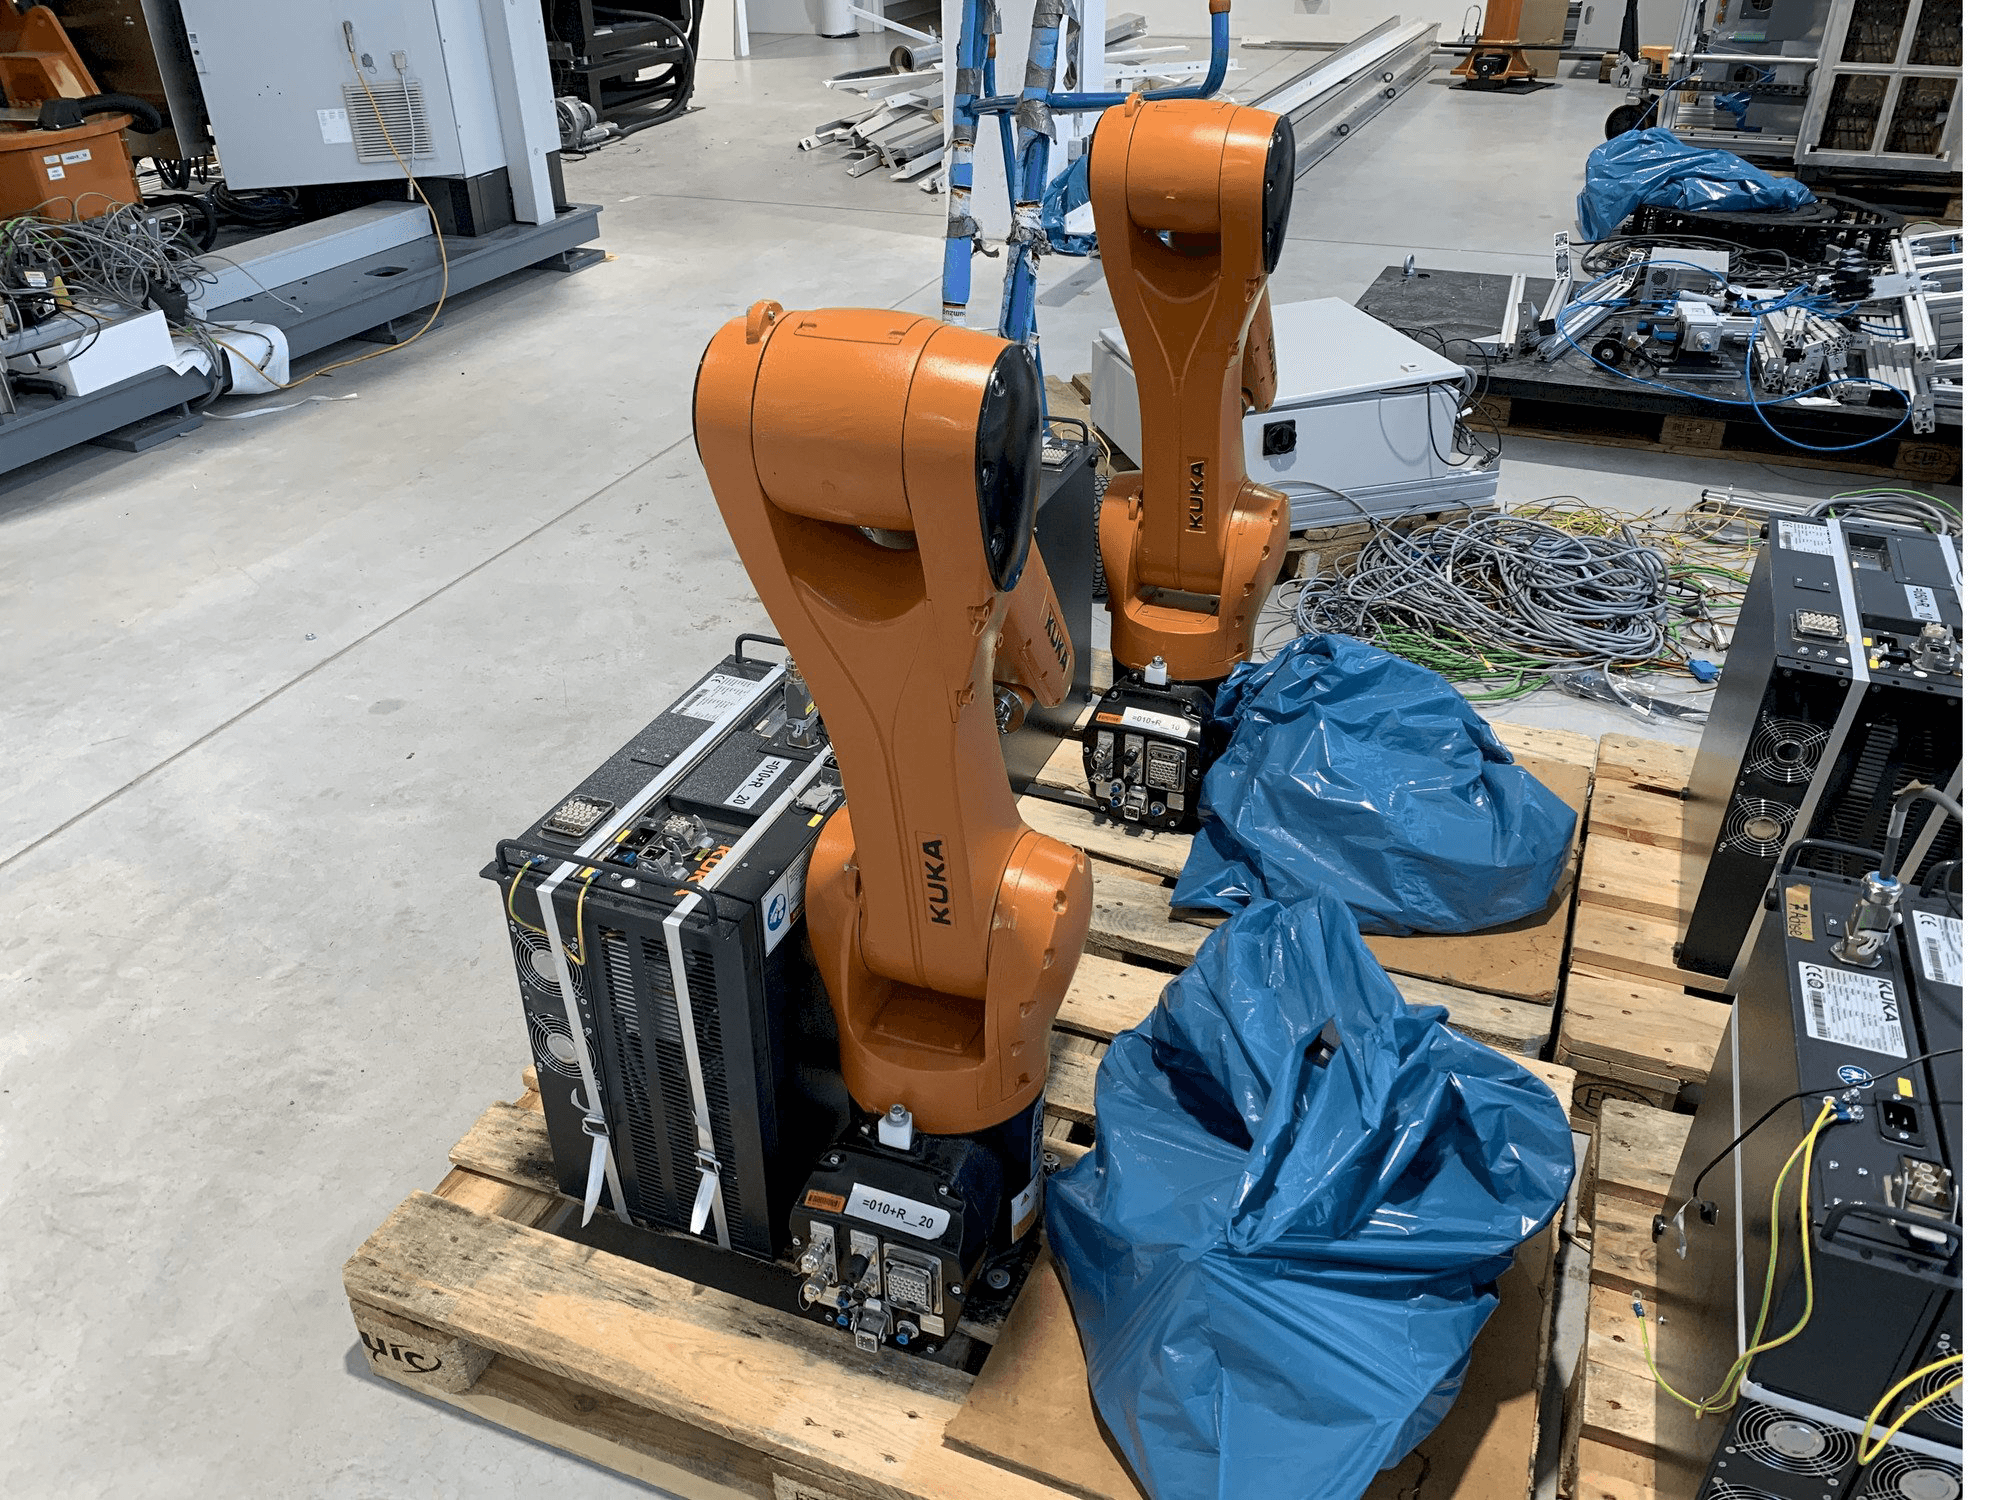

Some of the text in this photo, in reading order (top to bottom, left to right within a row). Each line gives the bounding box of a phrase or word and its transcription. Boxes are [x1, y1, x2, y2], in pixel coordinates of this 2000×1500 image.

[1190, 461, 1204, 528] KUKA
[1045, 610, 1067, 672] KUKA
[922, 839, 952, 926] KUKA
[1877, 979, 1899, 1022] KUKA
